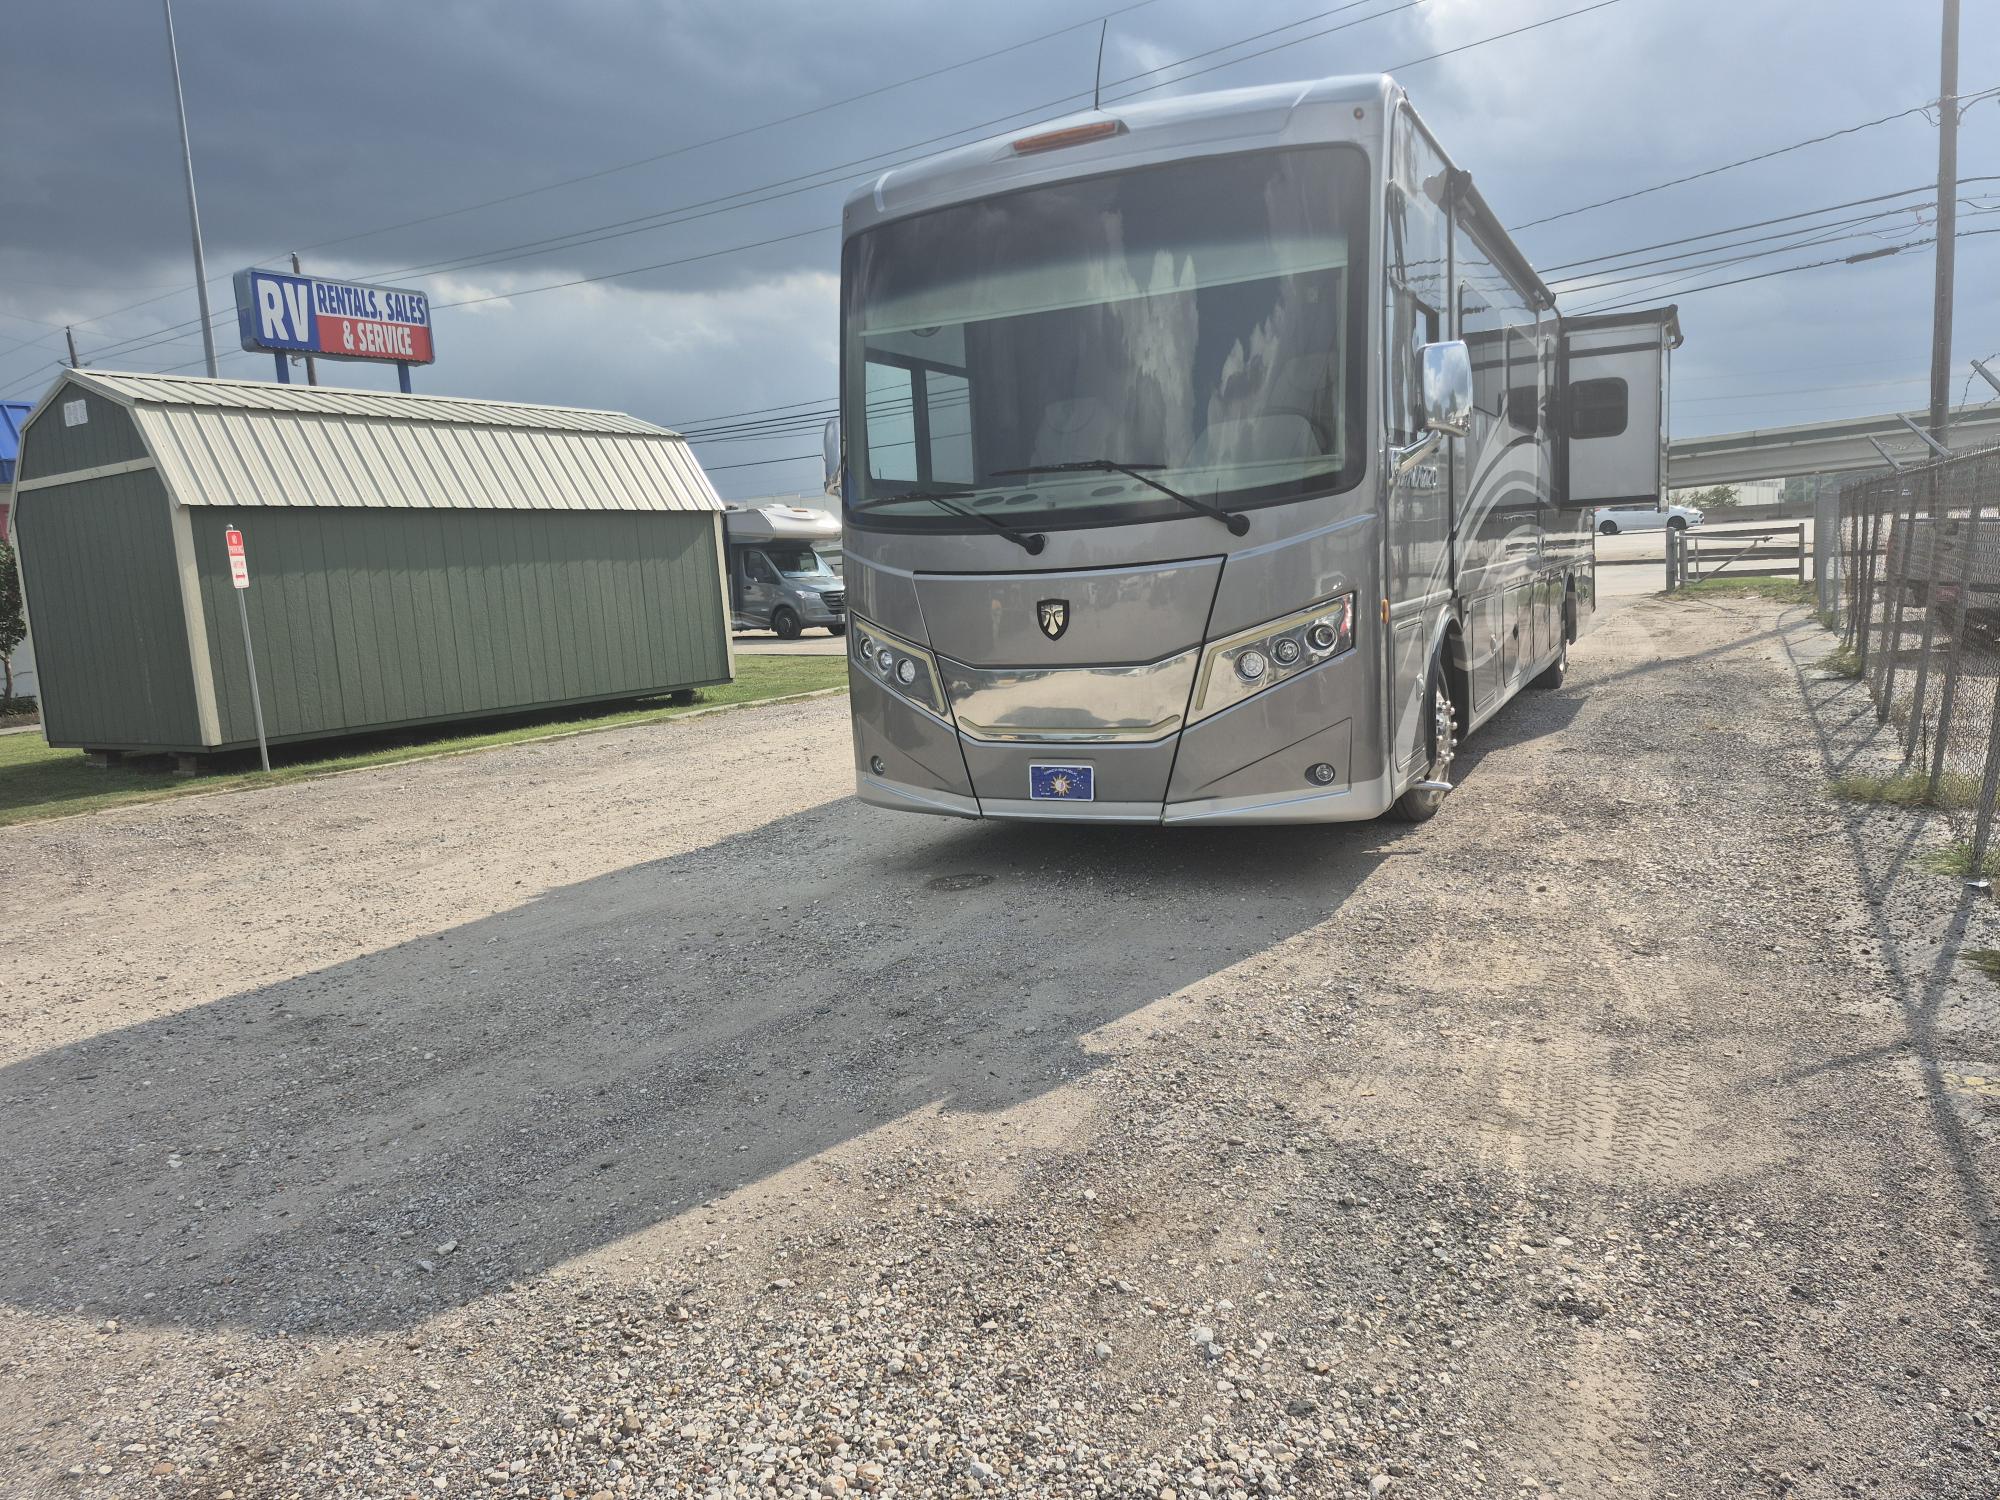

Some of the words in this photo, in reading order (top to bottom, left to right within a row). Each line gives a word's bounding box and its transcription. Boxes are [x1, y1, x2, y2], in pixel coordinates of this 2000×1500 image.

[256, 279, 309, 343] RV
[316, 284, 383, 321] RENTALS,
[385, 293, 425, 325] SALES
[342, 320, 355, 351] &
[357, 322, 413, 356] SERVICE
